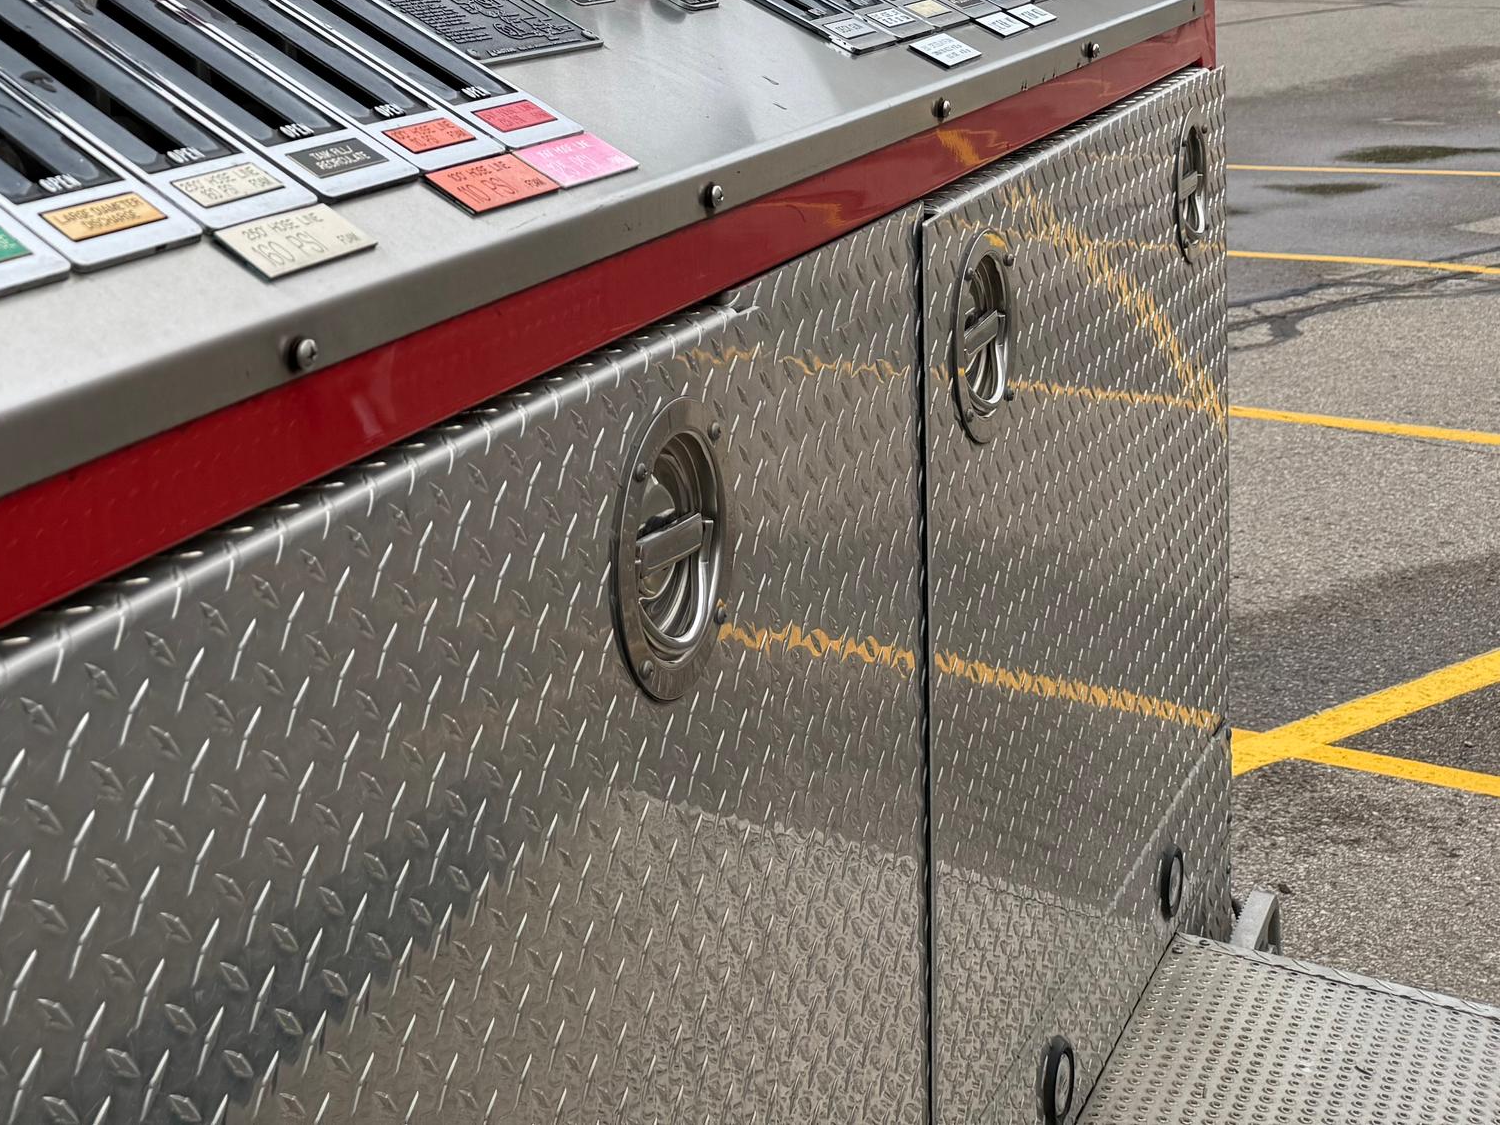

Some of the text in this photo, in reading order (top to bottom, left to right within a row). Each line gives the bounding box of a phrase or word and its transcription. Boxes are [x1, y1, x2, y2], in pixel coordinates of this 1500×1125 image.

[460, 86, 491, 98] OPEN
[374, 104, 405, 117] OPEN
[280, 123, 314, 138] OPEN
[166, 146, 206, 164] OPEN
[204, 172, 236, 184] HOSE
[233, 166, 259, 178] LINE
[469, 166, 492, 177] HOSE
[489, 161, 512, 172] LINE
[38, 173, 82, 192] OPEN
[481, 177, 518, 197] PSI
[53, 198, 143, 224] LARGE DIAMETER
[82, 209, 140, 229] DISCHARGE
[268, 218, 300, 233] HOSE
[299, 212, 324, 226] LINE
[252, 231, 361, 266] 160 PSI FOAM
